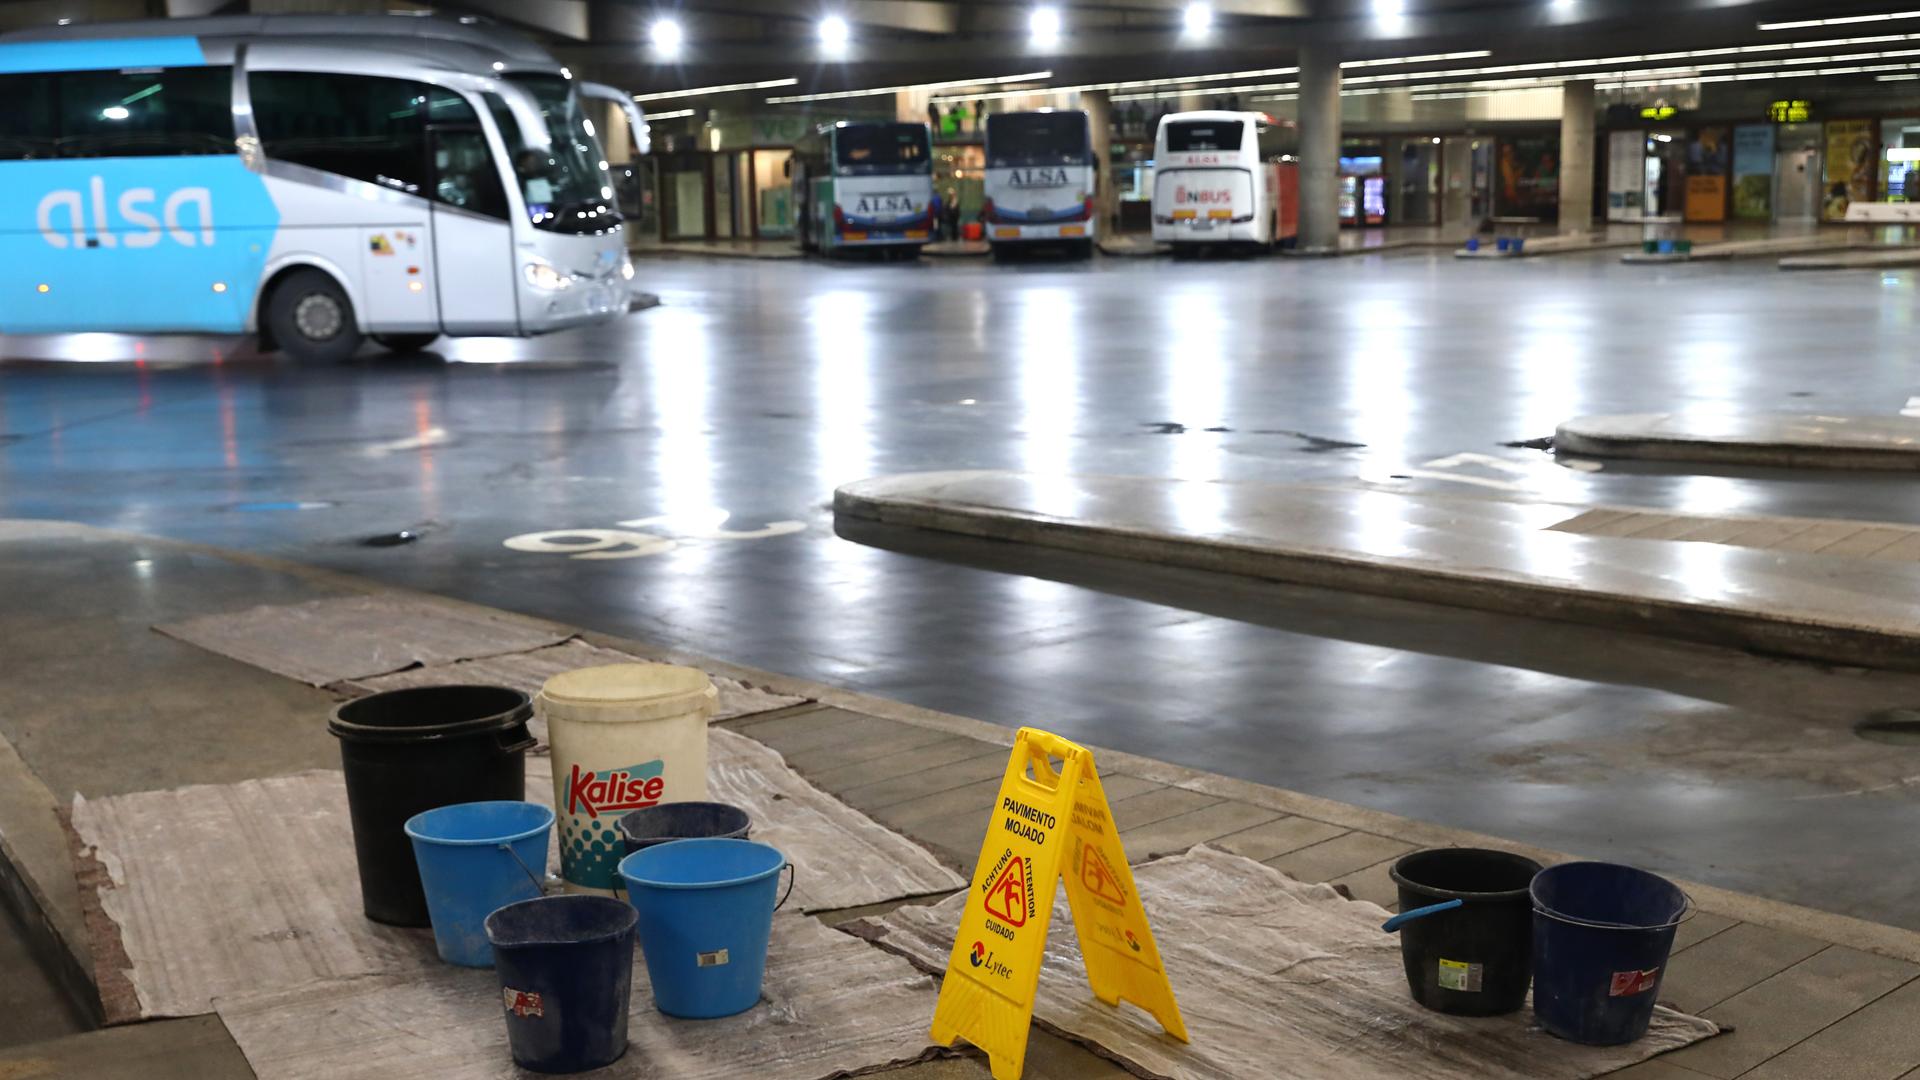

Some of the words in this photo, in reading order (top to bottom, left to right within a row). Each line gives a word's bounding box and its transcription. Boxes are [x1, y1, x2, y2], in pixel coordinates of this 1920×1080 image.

[1008, 168, 1069, 186] ALSA
[37, 176, 214, 249] alsa
[857, 197, 912, 213] ALSA
[569, 764, 664, 818] Kalise
[1003, 797, 1056, 830] PAVIMENTO
[1005, 818, 1045, 845] MOJADO
[982, 848, 1012, 893] ACHTUNG
[1025, 857, 1035, 918] ATTENTION
[985, 919, 1014, 941] CUIDADO
[985, 952, 1013, 979] Lytec
